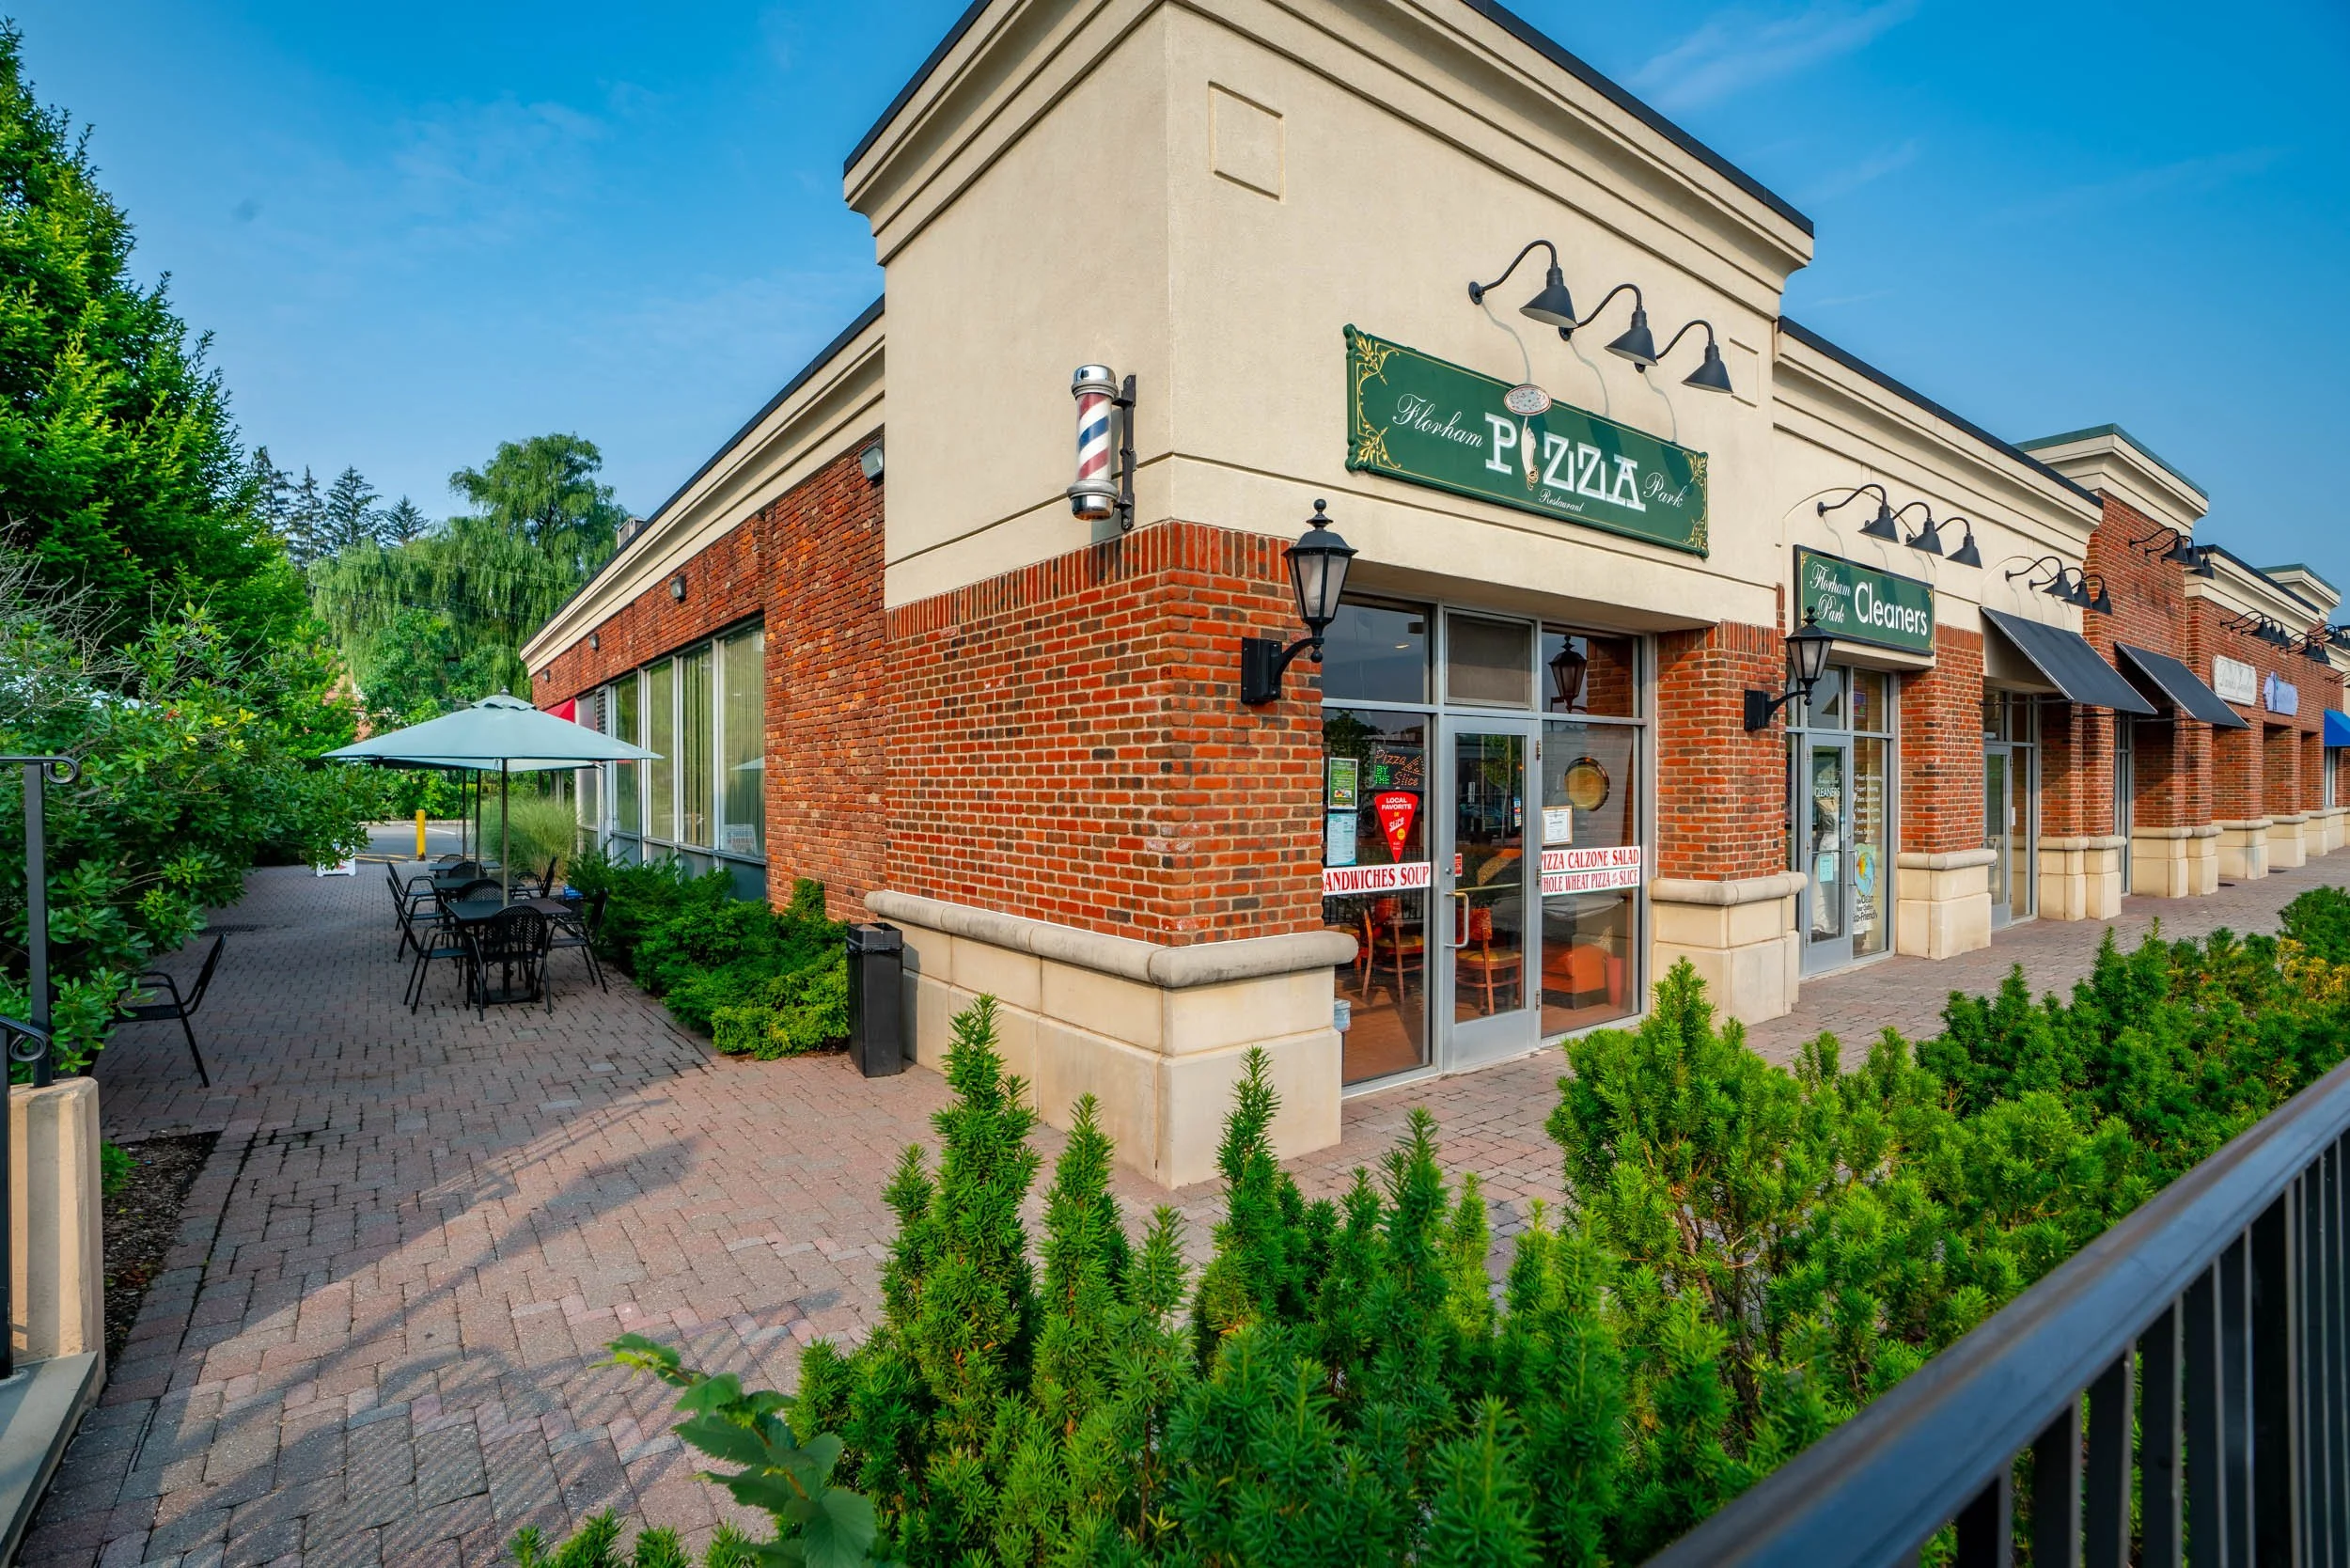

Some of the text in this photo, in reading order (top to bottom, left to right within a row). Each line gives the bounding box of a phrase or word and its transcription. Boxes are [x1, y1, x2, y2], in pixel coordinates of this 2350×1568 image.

[1392, 393, 1483, 447] Florham
[1643, 472, 1684, 509] Park
[1539, 489, 1585, 512] Restaurant
[1810, 561, 1851, 597] Florham
[1818, 593, 1844, 624] Park
[1855, 581, 1928, 636] Cleaners
[1374, 749, 1407, 765] Pizza
[1376, 765, 1389, 775] BY
[1392, 771, 1418, 786] Slice
[1814, 787, 1841, 798] CLEANERS
[1568, 850, 1608, 869] CALZONE
[1612, 849, 1639, 866] SALAD
[1322, 866, 1430, 892] ANDWICHES SOUP
[1565, 873, 1589, 891] WHEAT
[1590, 871, 1611, 889] PIZZA
[1620, 870, 1638, 886] SLICE
